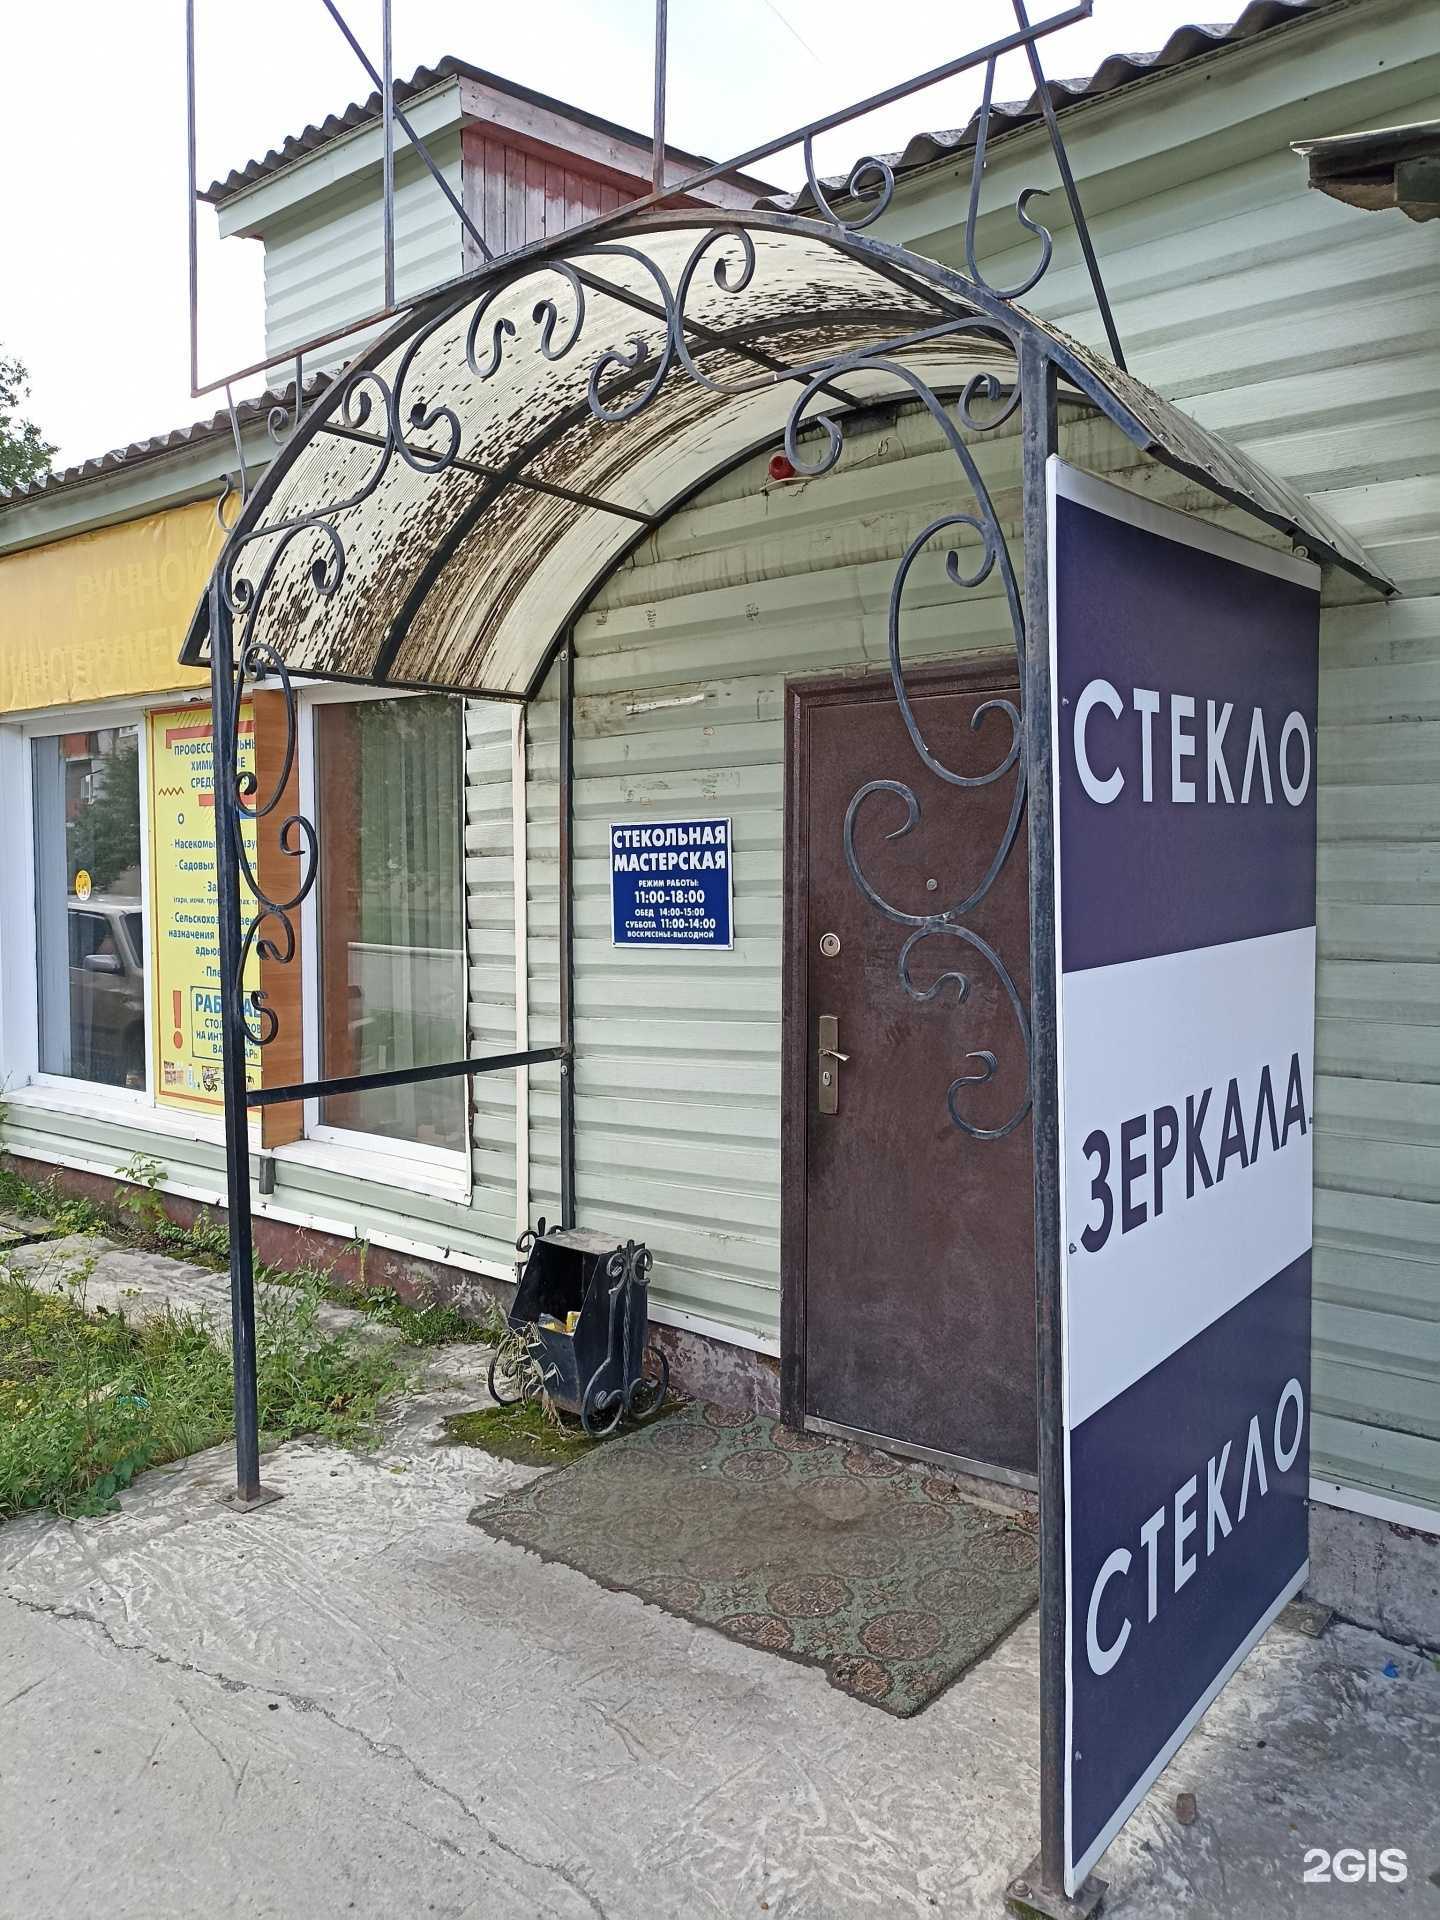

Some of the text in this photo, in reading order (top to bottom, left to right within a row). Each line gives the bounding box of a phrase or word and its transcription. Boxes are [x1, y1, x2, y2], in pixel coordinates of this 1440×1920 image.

[1073, 678, 1311, 807] СТЕКЛО
[613, 825, 726, 848] СТЕКОЛЬНАЯ
[174, 838, 217, 849] Насекомы
[179, 859, 215, 871] Садовых
[614, 850, 726, 872] МАСТЕРСКАЯ
[638, 879, 665, 888] РЕЖИМ
[634, 890, 705, 903] 11:00-18:00
[634, 908, 705, 917] ОБЕД 14:00-15:00
[625, 918, 716, 929] СУББОТА 11:00-14:00
[168, 929, 215, 940] назначения
[627, 930, 714, 939] ВОСКРЕСЕНЬЕ-ВЫХОДНОЙ
[1080, 1052, 1307, 1253] ЗЕРКАЛА
[1086, 1377, 1304, 1676] СТЕКЛО
